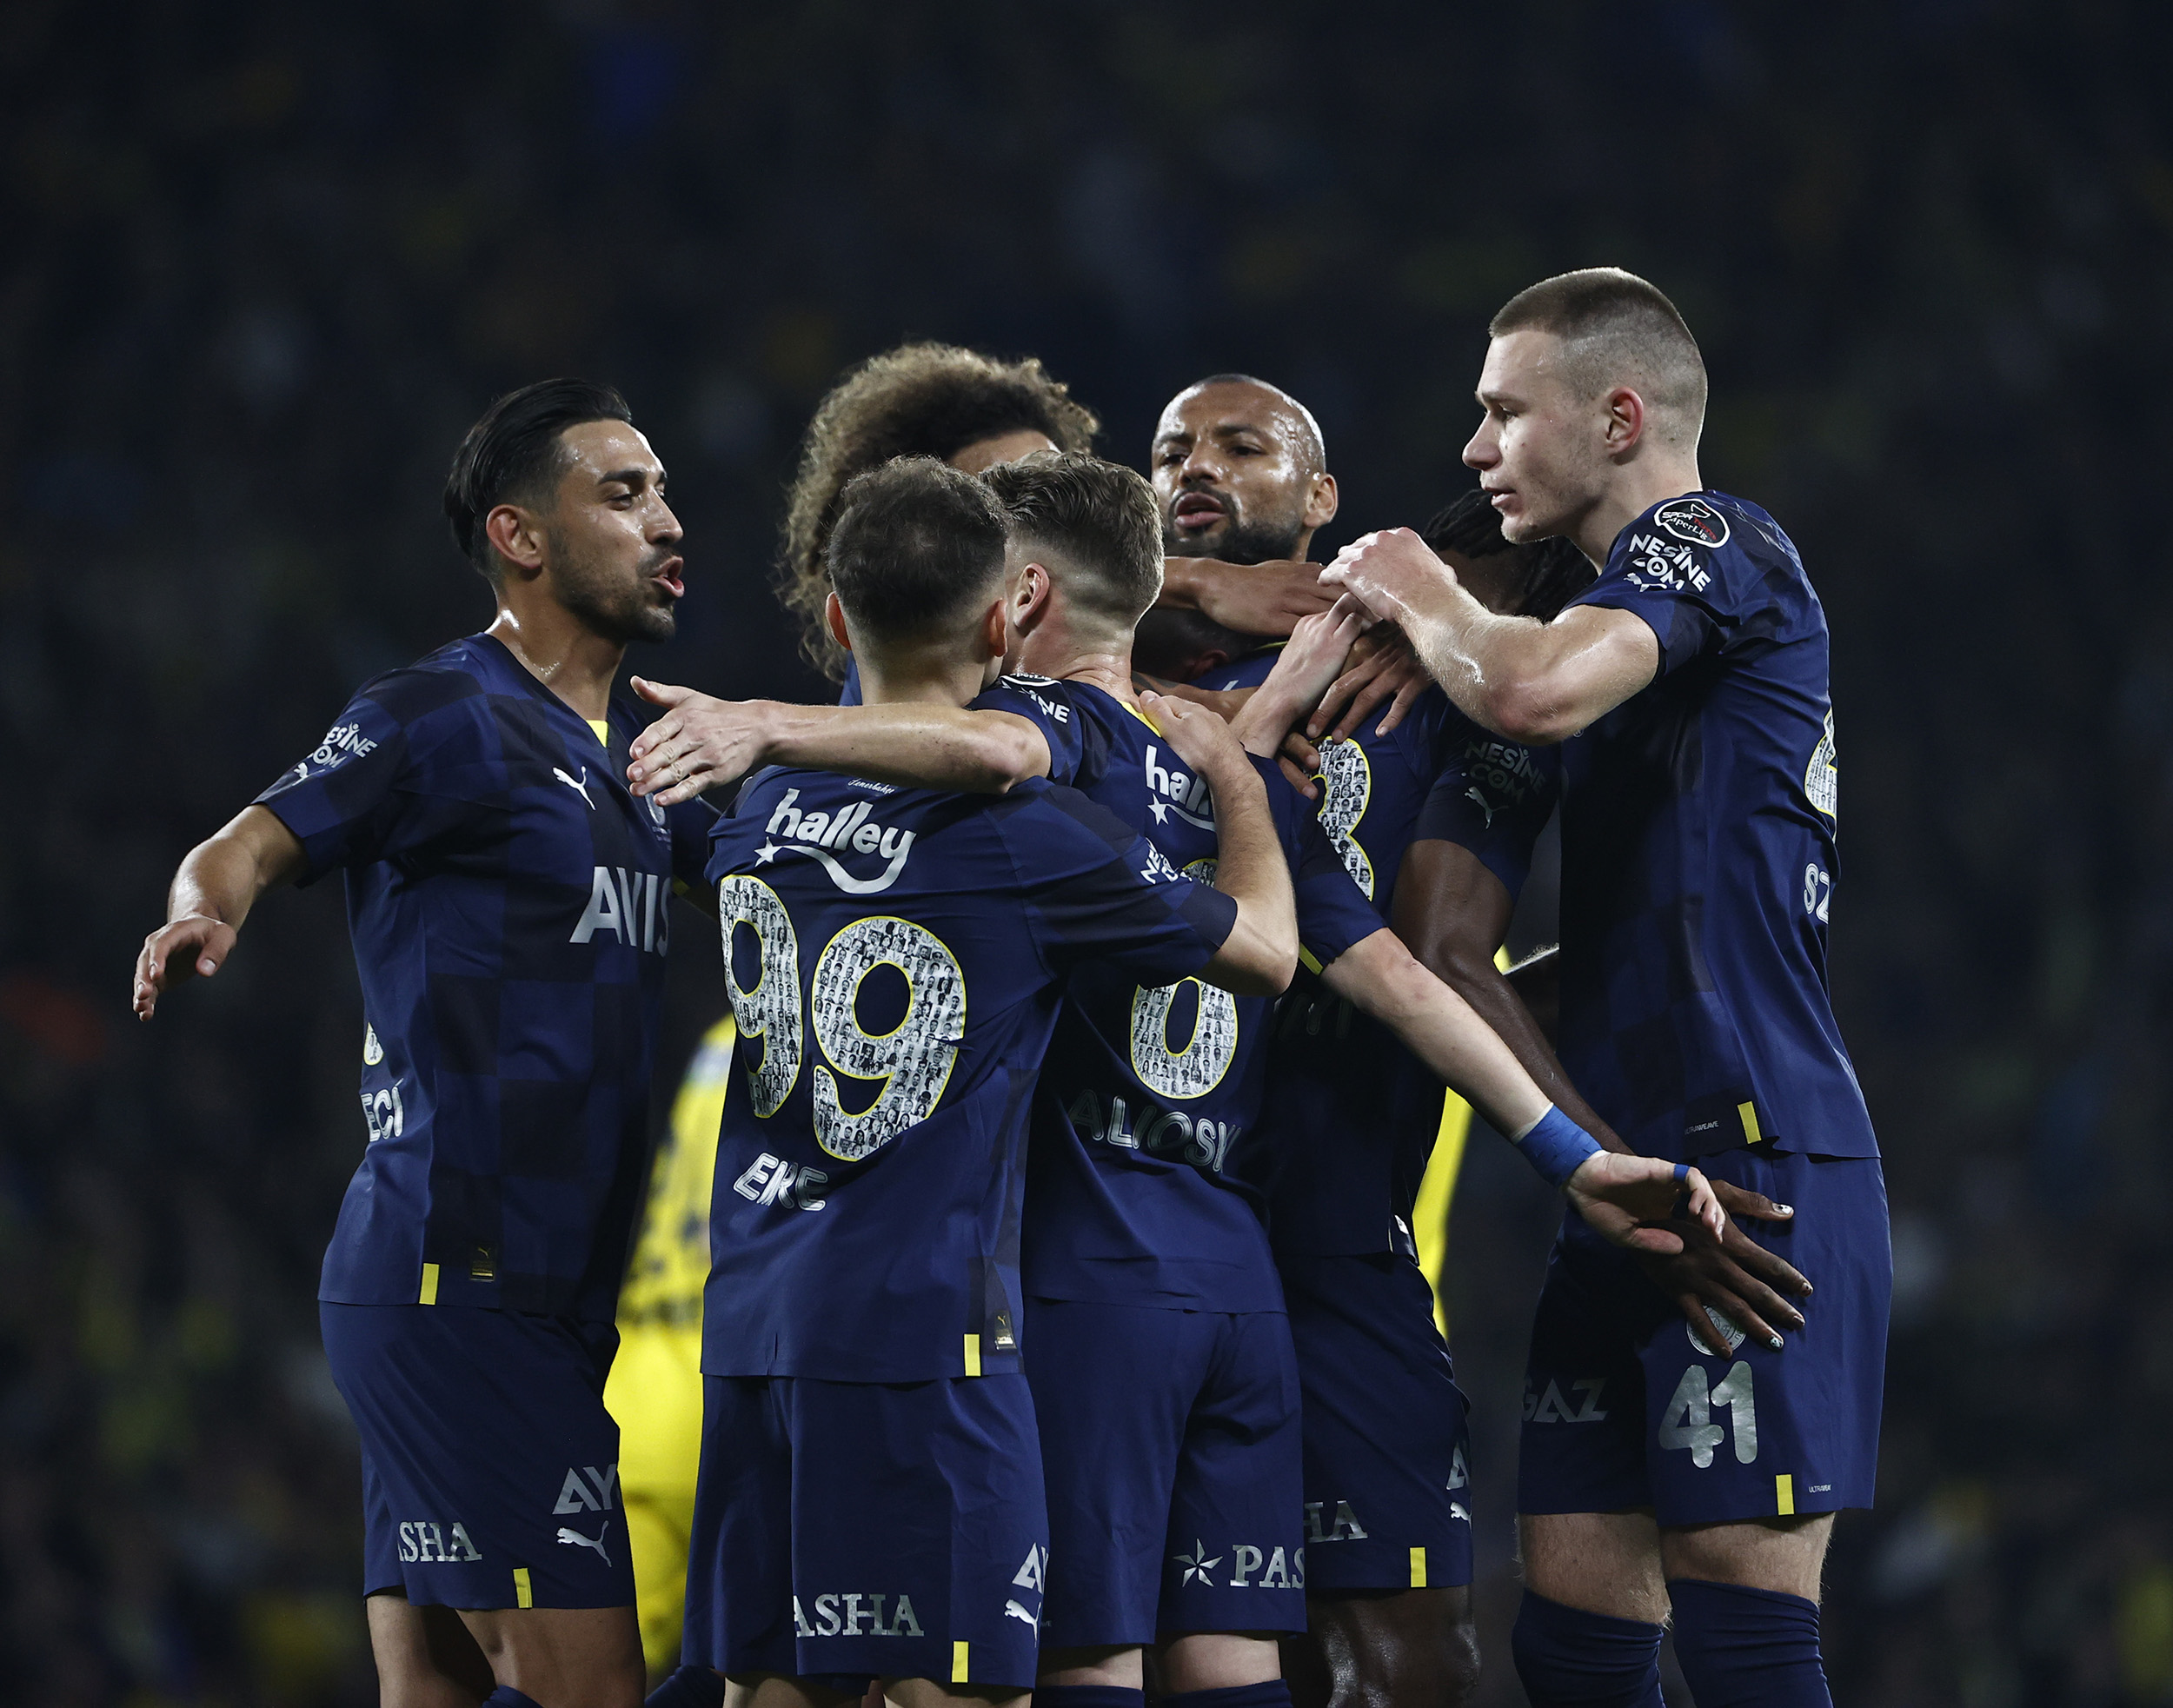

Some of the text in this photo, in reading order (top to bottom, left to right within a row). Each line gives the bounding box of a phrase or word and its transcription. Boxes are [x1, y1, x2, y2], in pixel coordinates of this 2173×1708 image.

[763, 788, 918, 894] halley
[568, 866, 671, 958] AVIS
[719, 874, 967, 1162] 99
[1658, 1359, 1759, 1469] 41
[397, 1521, 483, 1563] SHA
